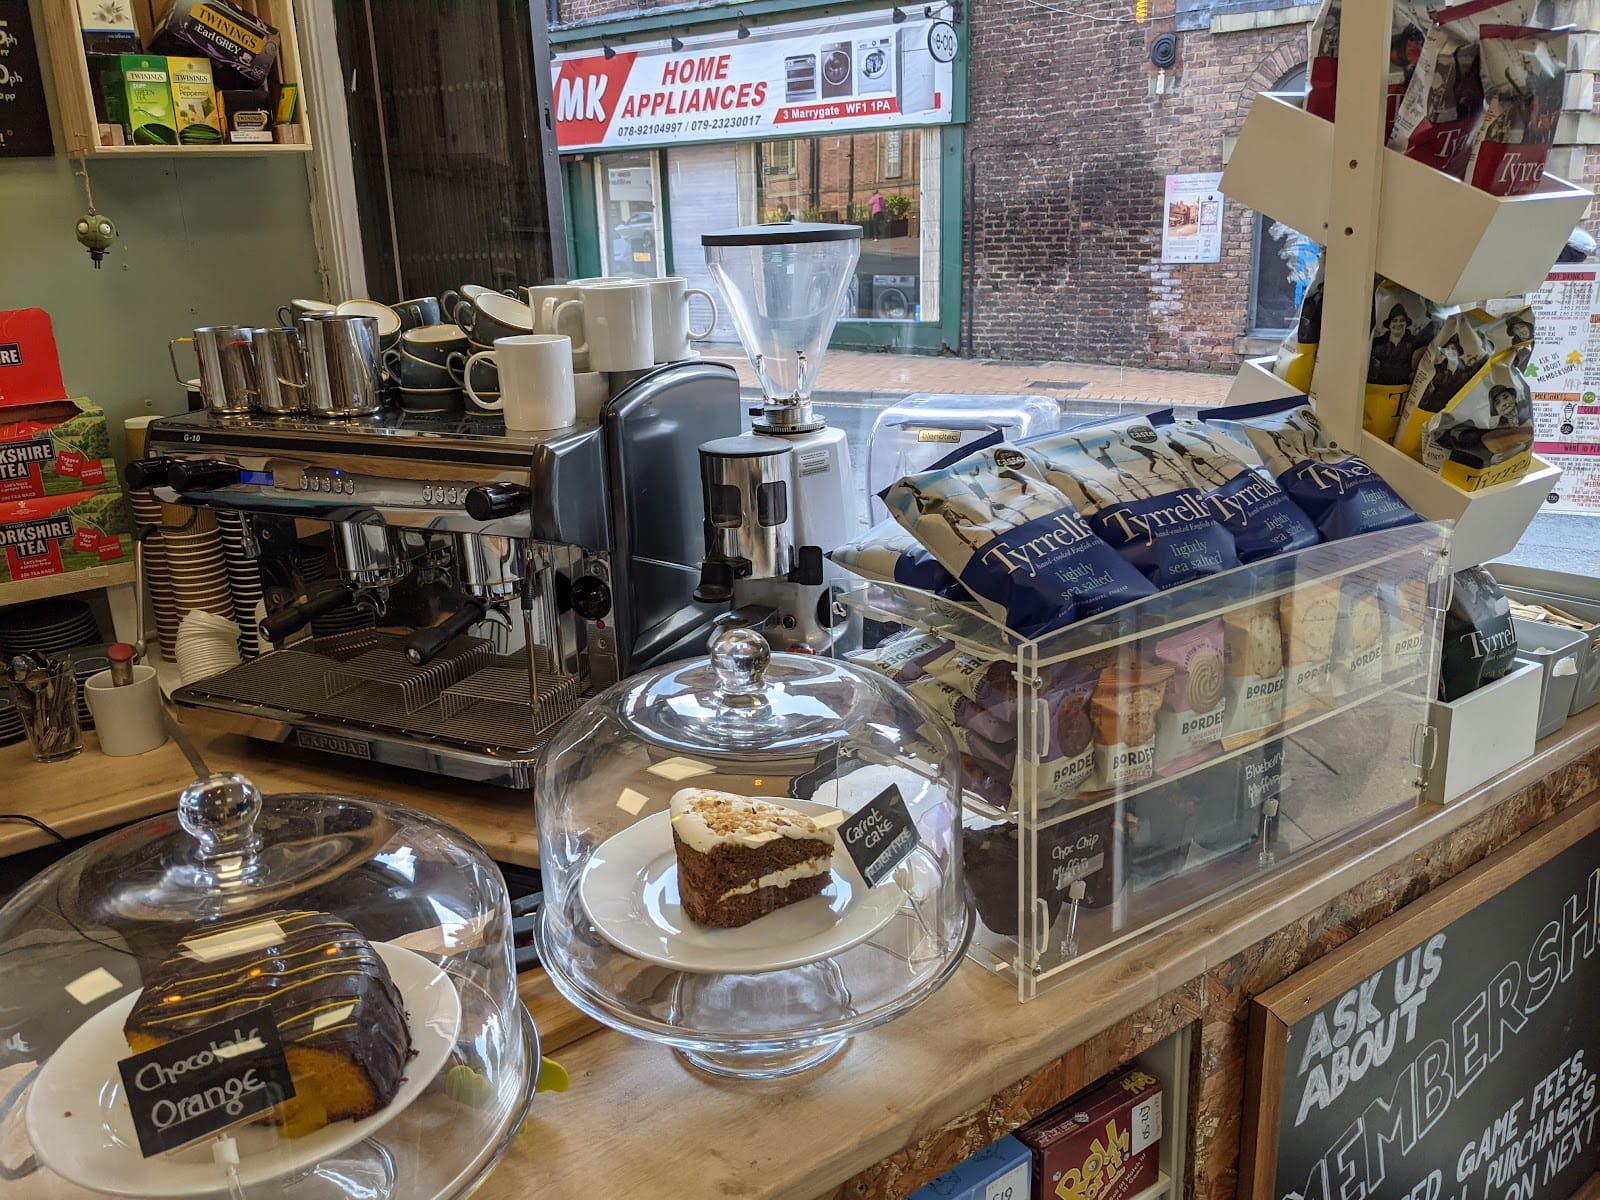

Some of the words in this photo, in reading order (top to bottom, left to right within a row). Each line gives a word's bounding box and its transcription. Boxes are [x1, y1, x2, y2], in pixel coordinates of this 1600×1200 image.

[196, 24, 215, 42] Earl
[215, 35, 242, 55] GREY
[199, 7, 257, 49] TWININGS
[936, 30, 953, 57] e-cig
[130, 72, 164, 80] TWININGS
[661, 54, 731, 86] HOME
[556, 73, 608, 123] MK
[620, 81, 768, 119] APPLIANCES
[783, 110, 788, 119] 3
[792, 105, 840, 119] Marrygate
[846, 102, 867, 113] WF1
[871, 100, 891, 111] 1PA
[617, 123, 682, 137] 078-92104997
[685, 120, 690, 133] /
[691, 115, 762, 131] 079-23230017
[1539, 356, 1549, 365] ASK
[1551, 351, 1560, 359] US
[1543, 360, 1561, 372] ABOUT
[183, 433, 201, 442] G-10
[1129, 429, 1156, 439] taste
[0, 462, 28, 478] TEA
[17, 540, 47, 556] TEA
[1169, 537, 1208, 558] lightly
[1055, 562, 1095, 583] lightly
[1168, 562, 1190, 576] sea
[1190, 550, 1224, 568] salted
[1060, 586, 1082, 601] sea
[1081, 570, 1115, 592] salted
[877, 642, 933, 670] BORDER
[1245, 750, 1286, 780] Blueberry
[845, 807, 883, 844] Carrot
[1051, 845, 1075, 860] Choc
[1076, 834, 1100, 851] Chip
[1297, 970, 1383, 1077] ASK
[1394, 932, 1447, 1004] US
[1294, 988, 1427, 1128] ABOUT
[151, 1068, 267, 1128] Orange
[1456, 1097, 1524, 1183] GAME
[1529, 1049, 1587, 1121] FEES,
[1484, 1073, 1597, 1200] PURCHASES
[1542, 1104, 1600, 1186] NEXT
